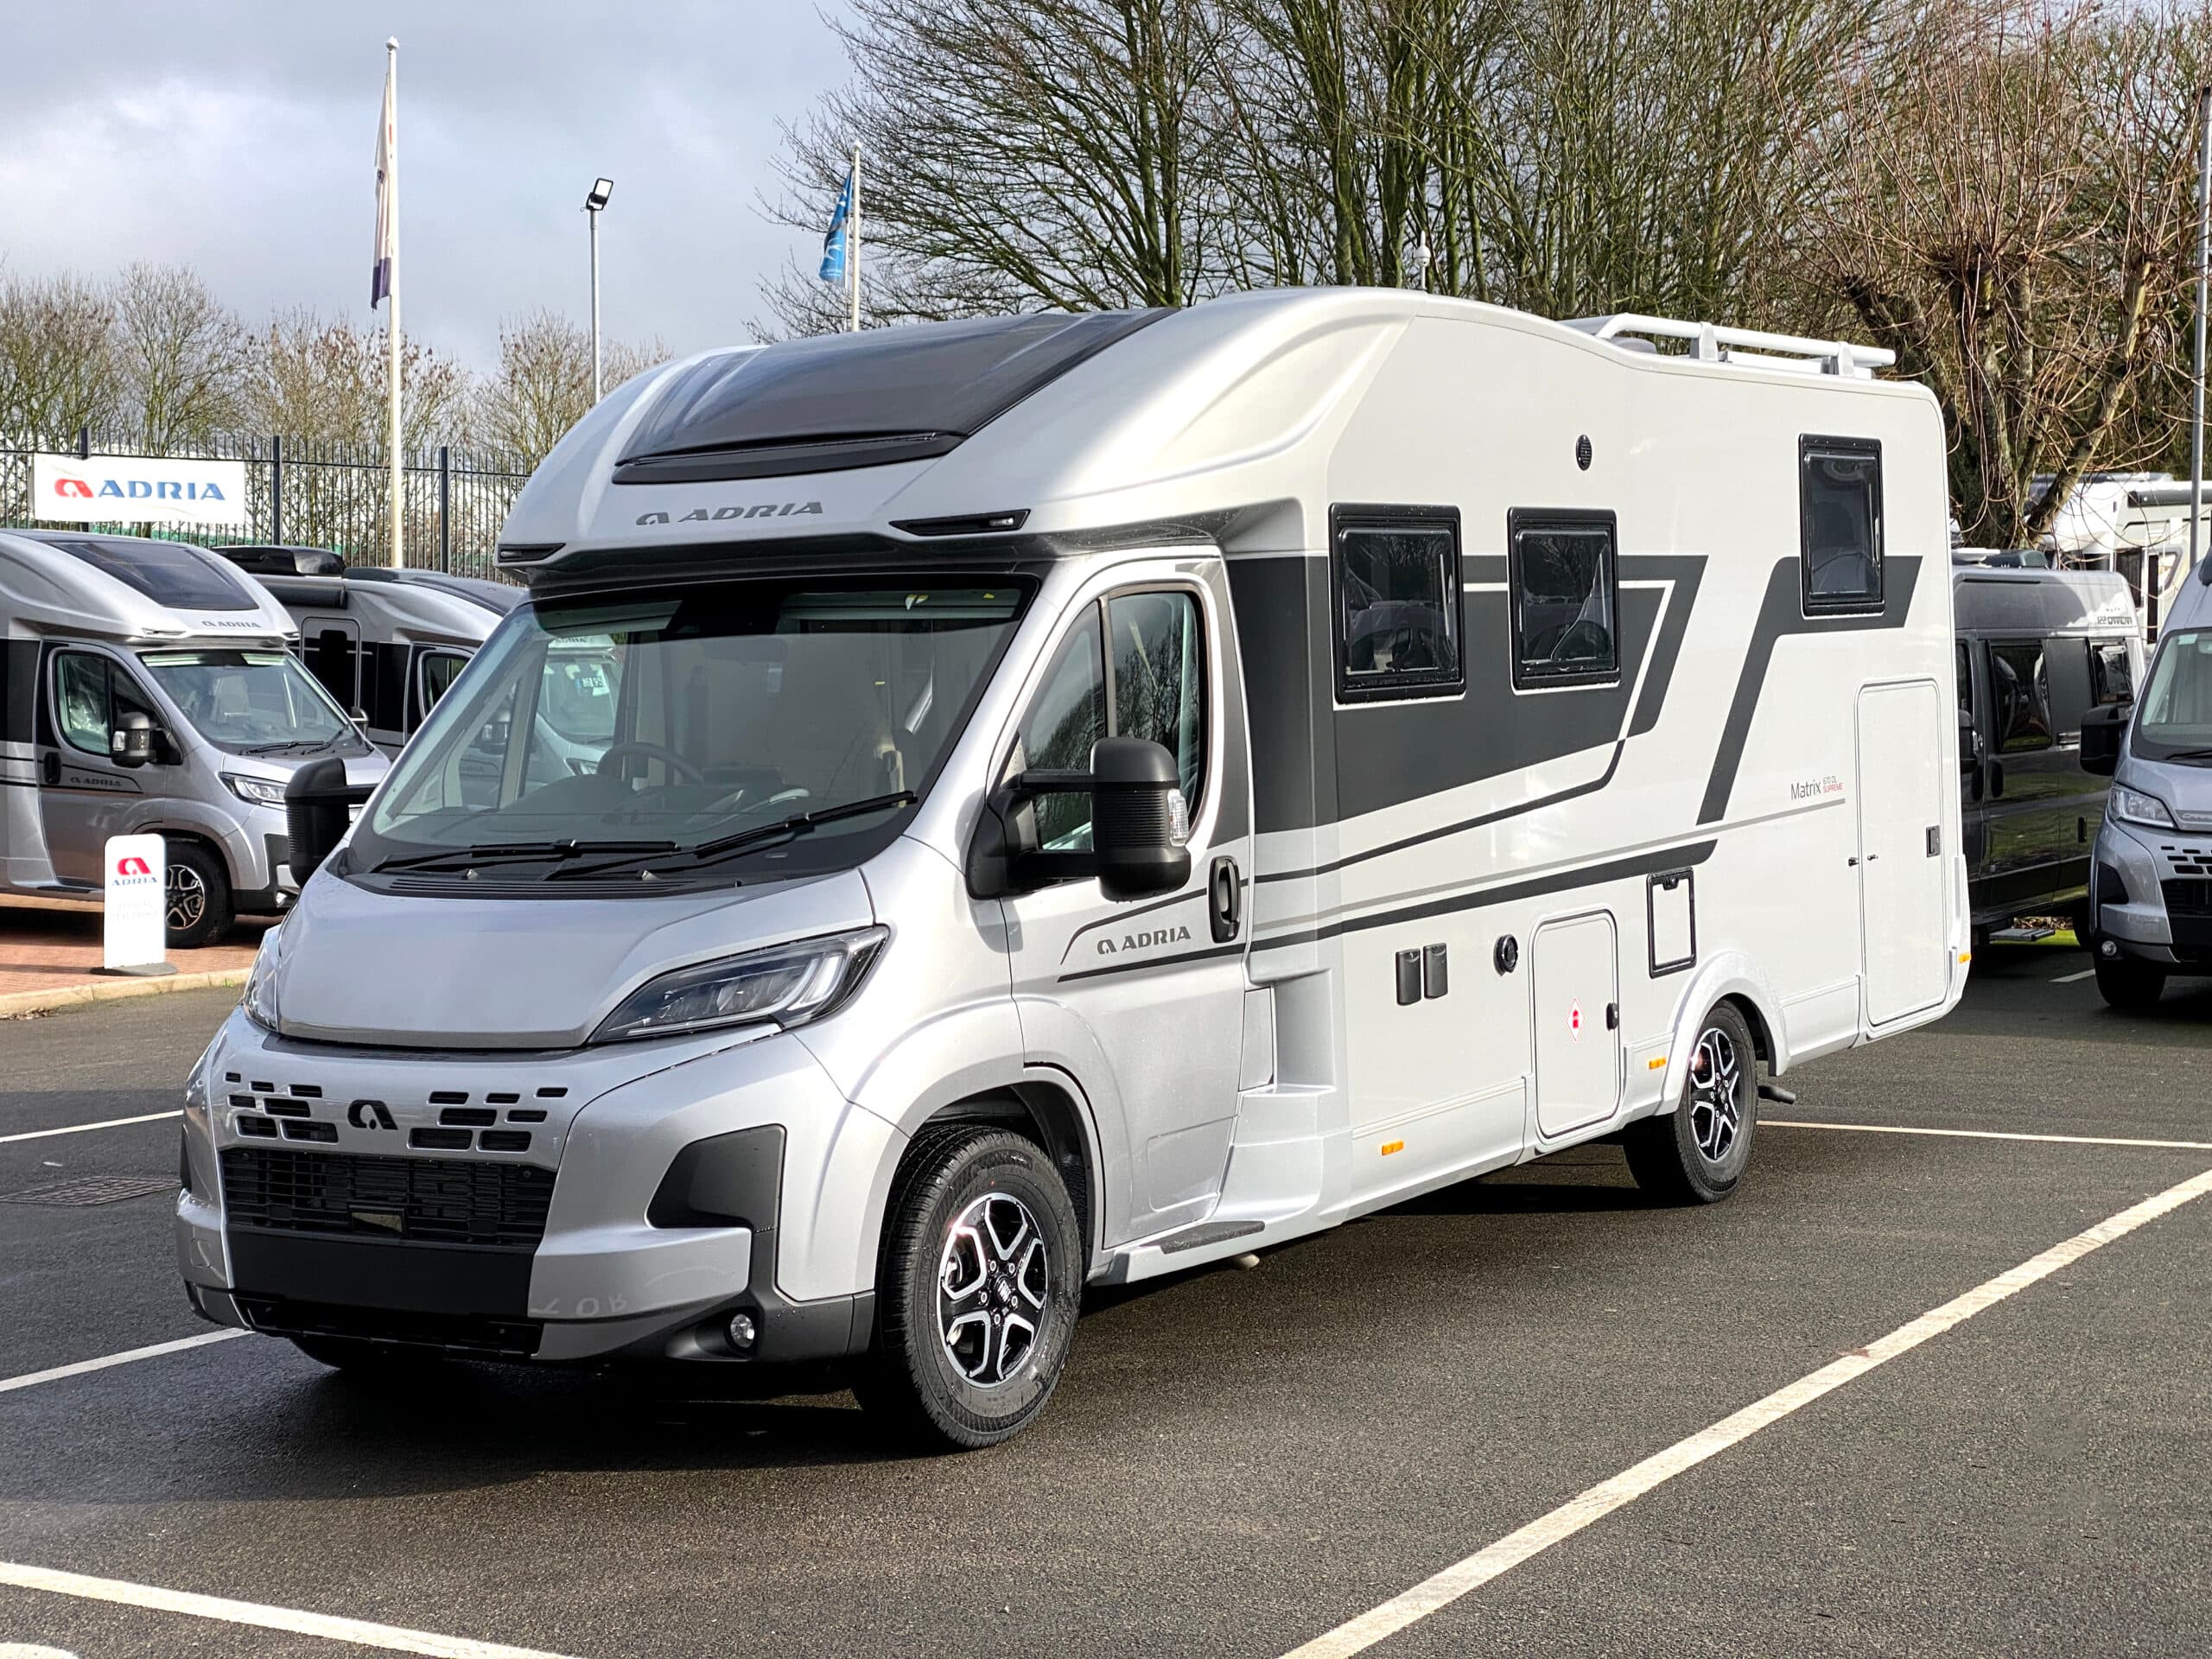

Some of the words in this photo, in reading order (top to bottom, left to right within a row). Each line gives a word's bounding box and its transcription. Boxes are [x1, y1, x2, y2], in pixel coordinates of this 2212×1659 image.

[99, 480, 226, 500] ADRIA
[678, 501, 823, 523] ADRIA
[1790, 779, 1821, 801] Matrix
[111, 876, 158, 887] ADRIA
[1121, 925, 1192, 952] ADRIA
